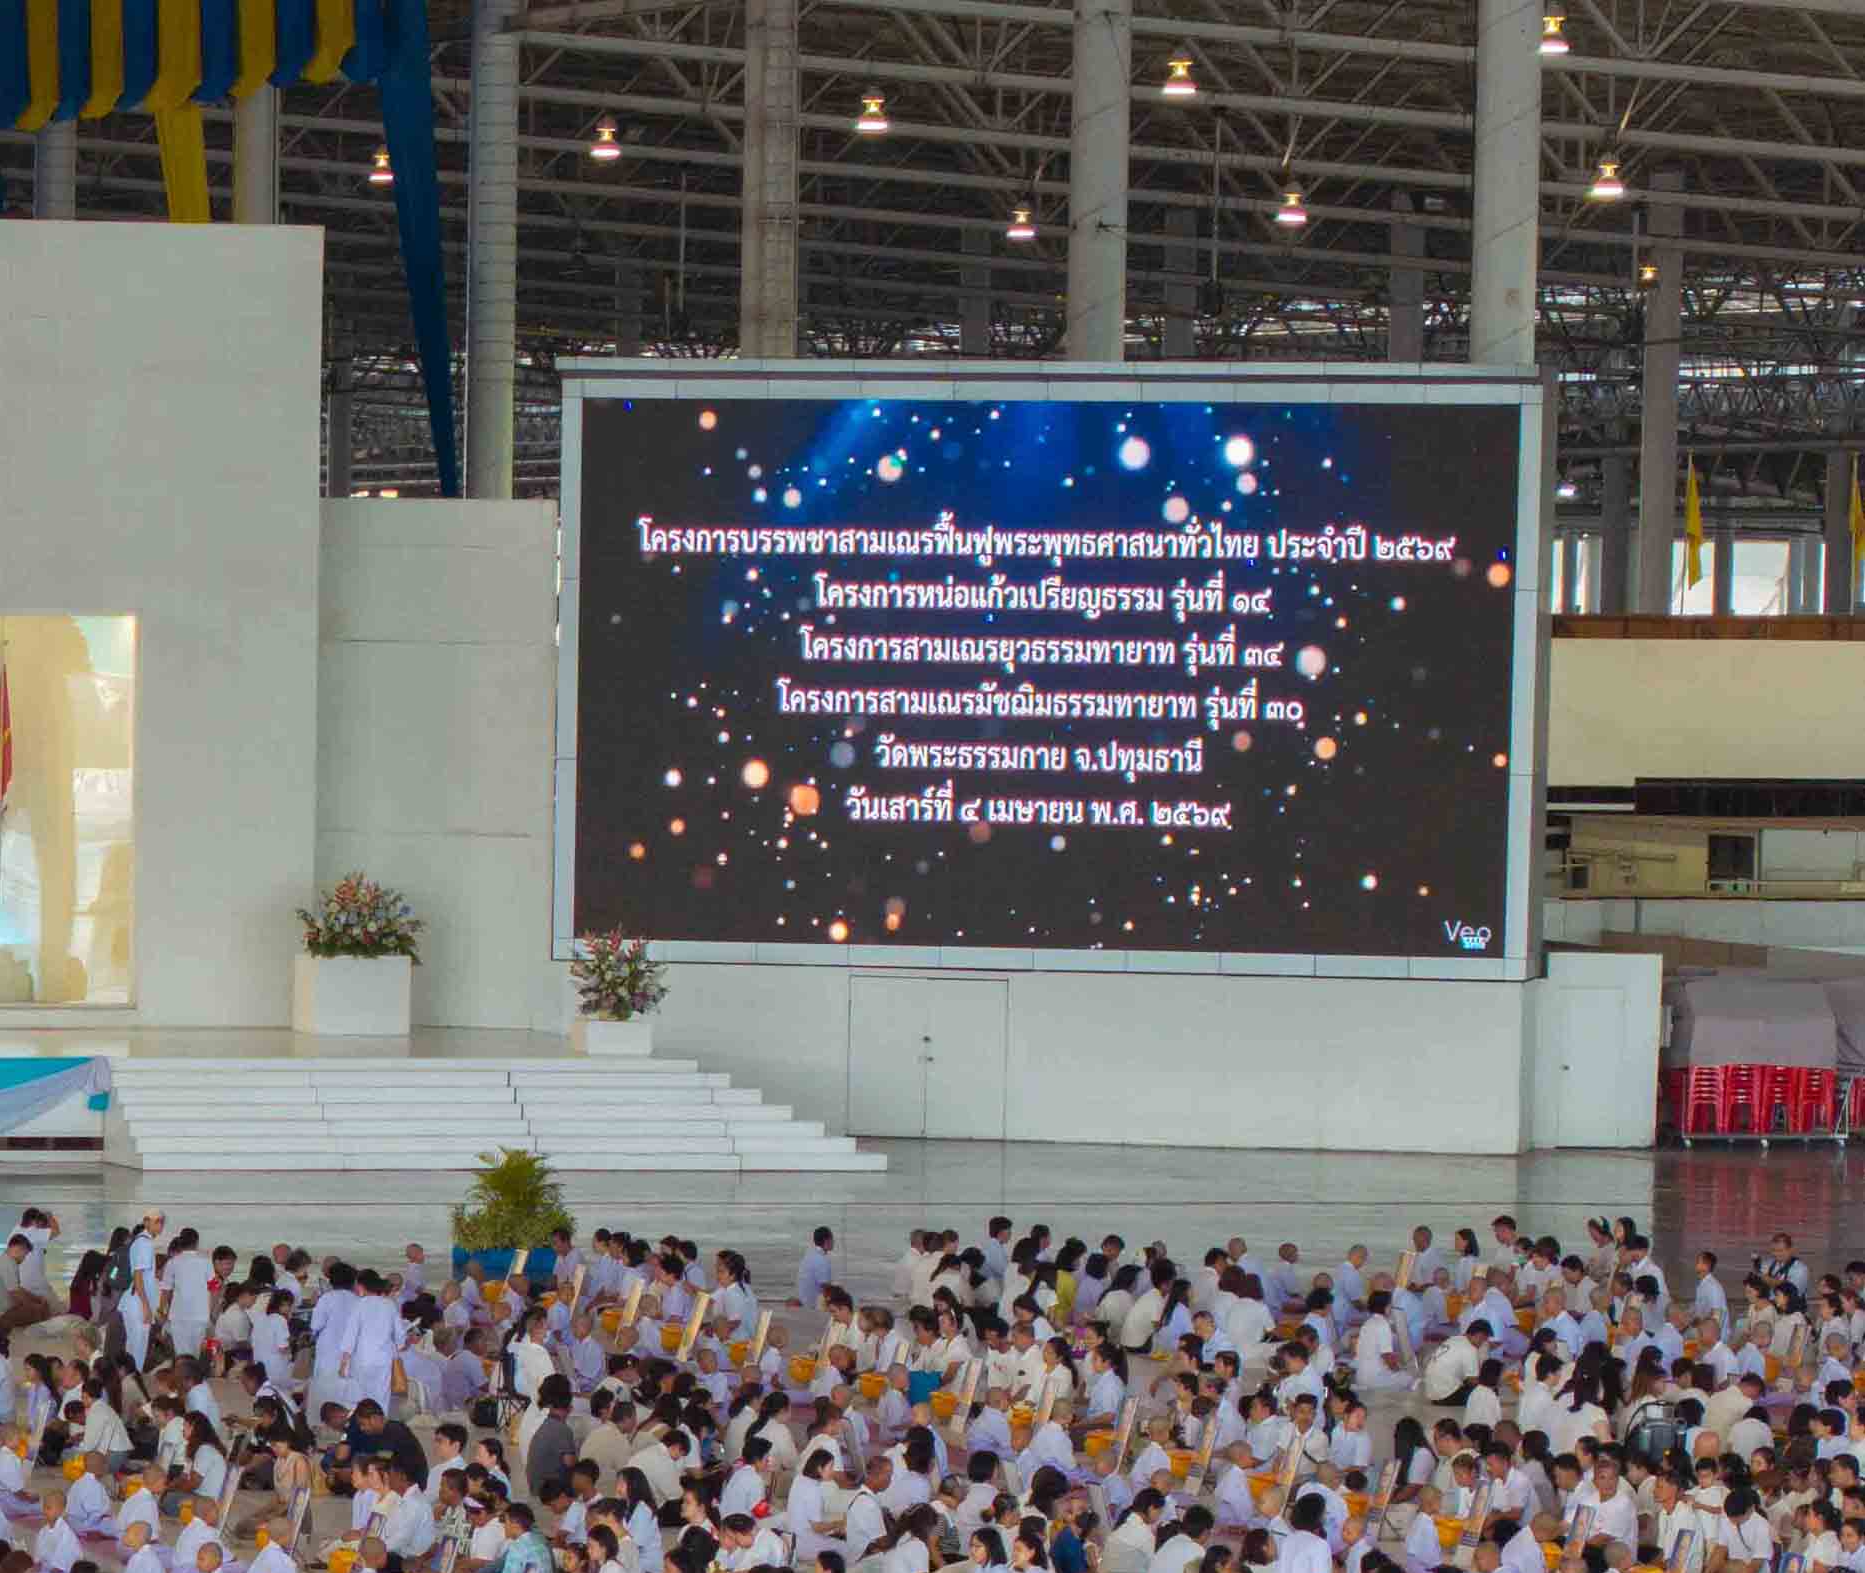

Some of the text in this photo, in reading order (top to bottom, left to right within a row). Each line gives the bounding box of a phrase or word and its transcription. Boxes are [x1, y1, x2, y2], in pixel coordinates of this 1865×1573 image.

[1269, 524, 1366, 562] ประจำปี
[1375, 534, 1457, 561] ๒๕๖๙
[814, 569, 1272, 623] โครงการหน่อแก้วเปรียญธรรม รุ่นที่ ๑๔
[799, 623, 1284, 676] โครงการสามเณรยุวธรรมทายาท รุ่นที่ ๓๔
[776, 677, 1305, 731] โครงการสามเณรมัชฌิมธรรมทายาท รุ่นที่ ๓๐
[876, 734, 1203, 782] วัดพระธรรมกาย จ.ปทุมธานี
[846, 781, 1233, 828] วันเสาร์ที่ ๔ เมษายน พ.ศ. ๒๕๖๙
